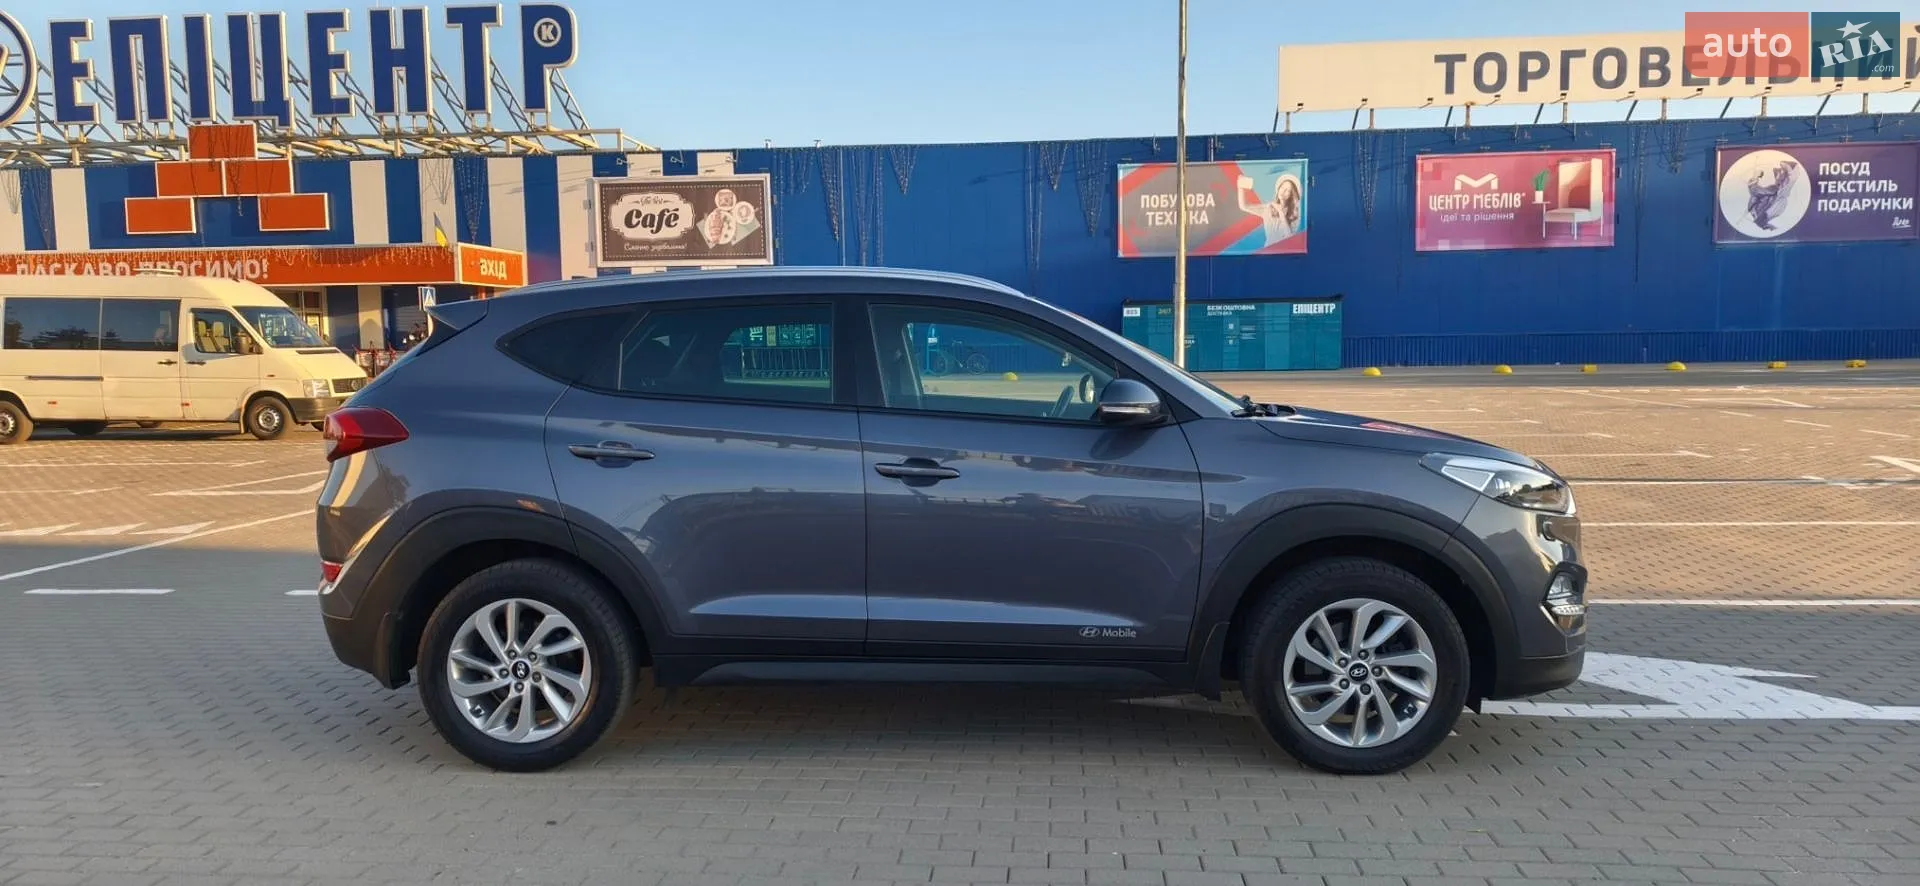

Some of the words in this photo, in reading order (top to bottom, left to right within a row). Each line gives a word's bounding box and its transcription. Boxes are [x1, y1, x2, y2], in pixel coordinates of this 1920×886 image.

[47, 3, 578, 131] ЕПІЦЕНТР
[1819, 161, 1871, 177] ПОСУД
[1818, 179, 1898, 194] ТЕКСТИЛЬ
[1140, 193, 1216, 209] ПОБУОВА
[1428, 194, 1469, 213] ЦЕНТР
[1817, 197, 1914, 213] ПОДАРУНКИ
[624, 208, 679, 235] Café
[1145, 210, 1210, 226] ТЕХКА
[1461, 213, 1471, 222] та
[1473, 212, 1515, 224] рішення
[479, 257, 508, 281] ВХІД
[1102, 628, 1136, 638] Mobile
